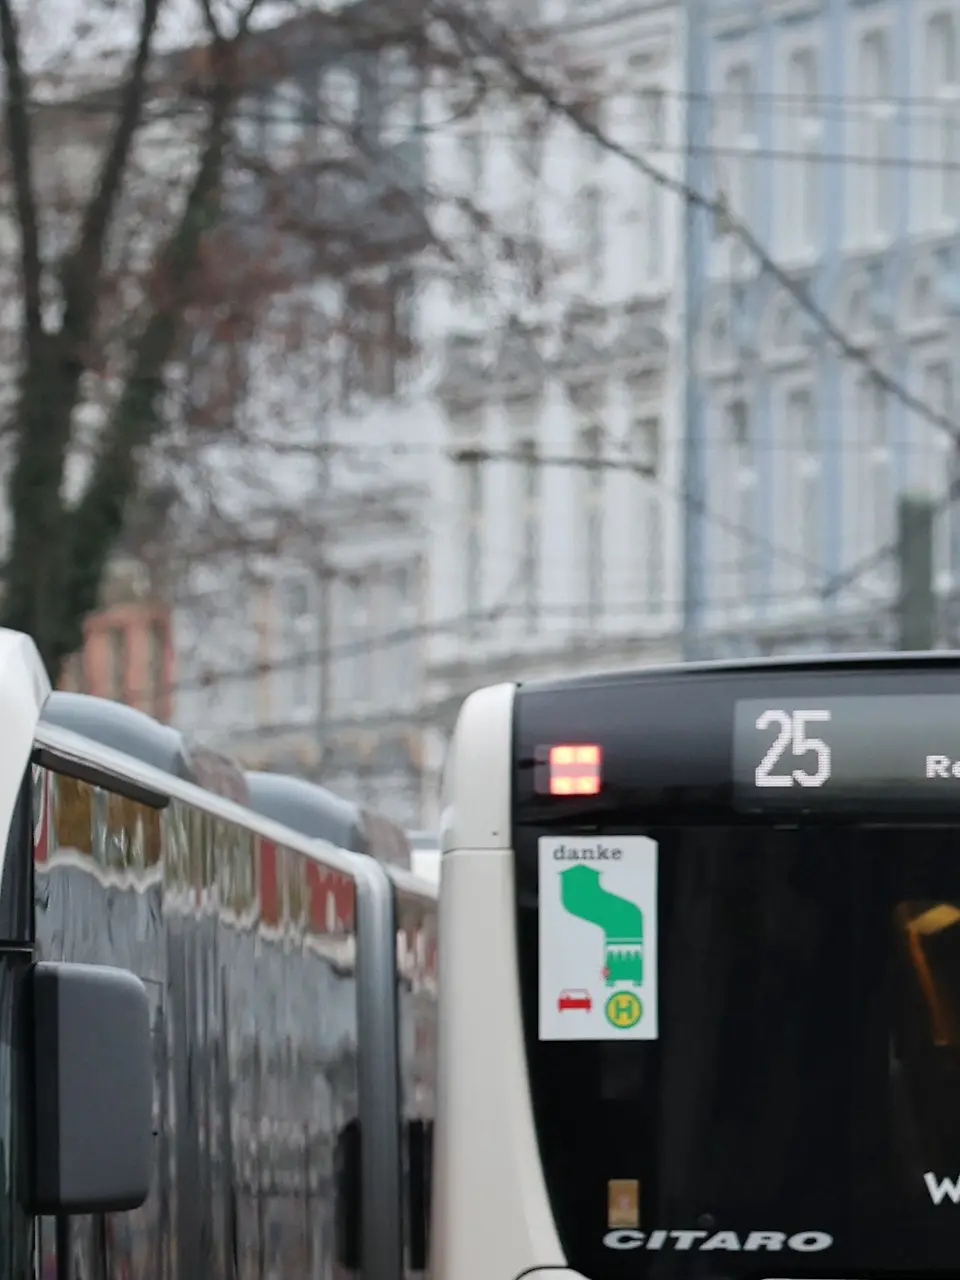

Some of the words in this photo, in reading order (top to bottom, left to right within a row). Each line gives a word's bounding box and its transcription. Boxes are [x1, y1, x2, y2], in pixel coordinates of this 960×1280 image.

[755, 709, 832, 787] 25
[553, 845, 623, 860] danke
[603, 1229, 834, 1252] CITARO
